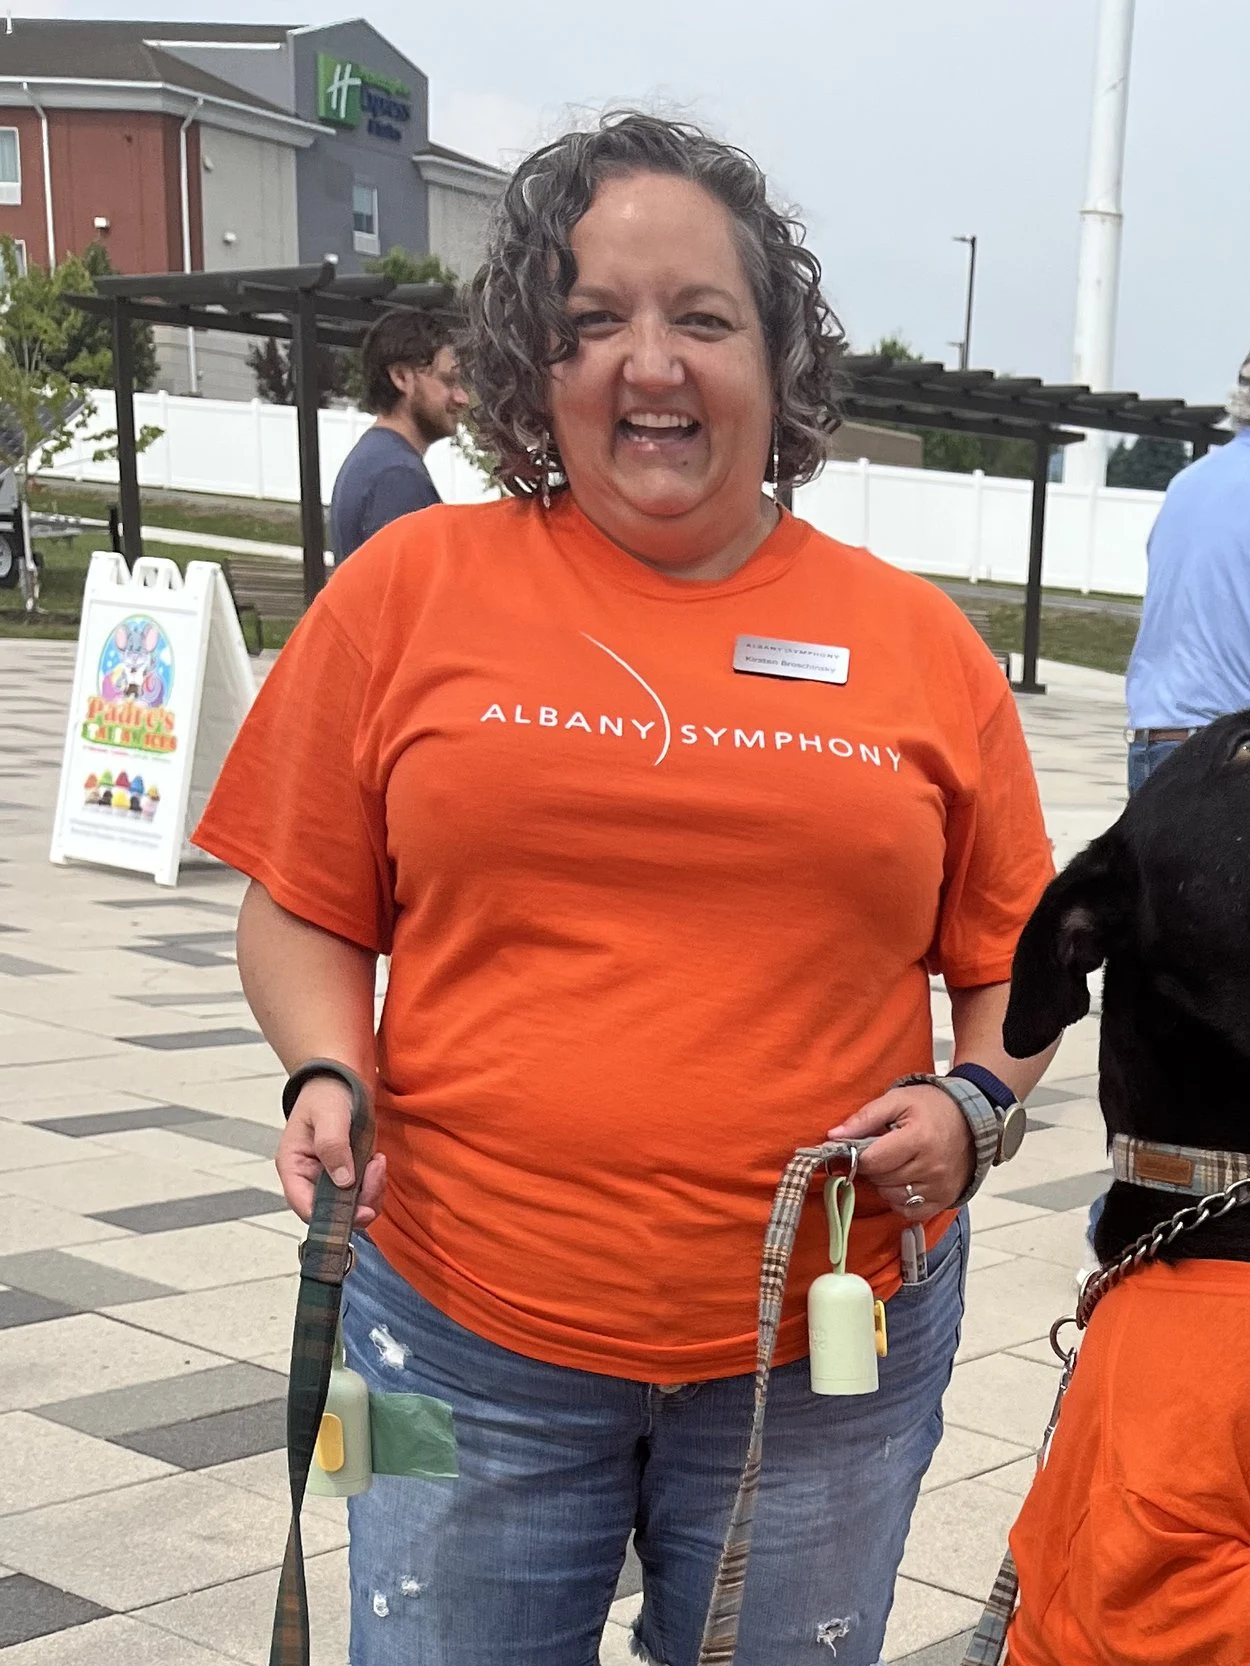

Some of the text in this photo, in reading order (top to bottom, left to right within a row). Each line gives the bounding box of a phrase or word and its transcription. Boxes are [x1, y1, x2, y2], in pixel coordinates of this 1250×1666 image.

[86, 695, 176, 731] Padre's
[480, 703, 901, 772] ALBANY SYMPHONY
